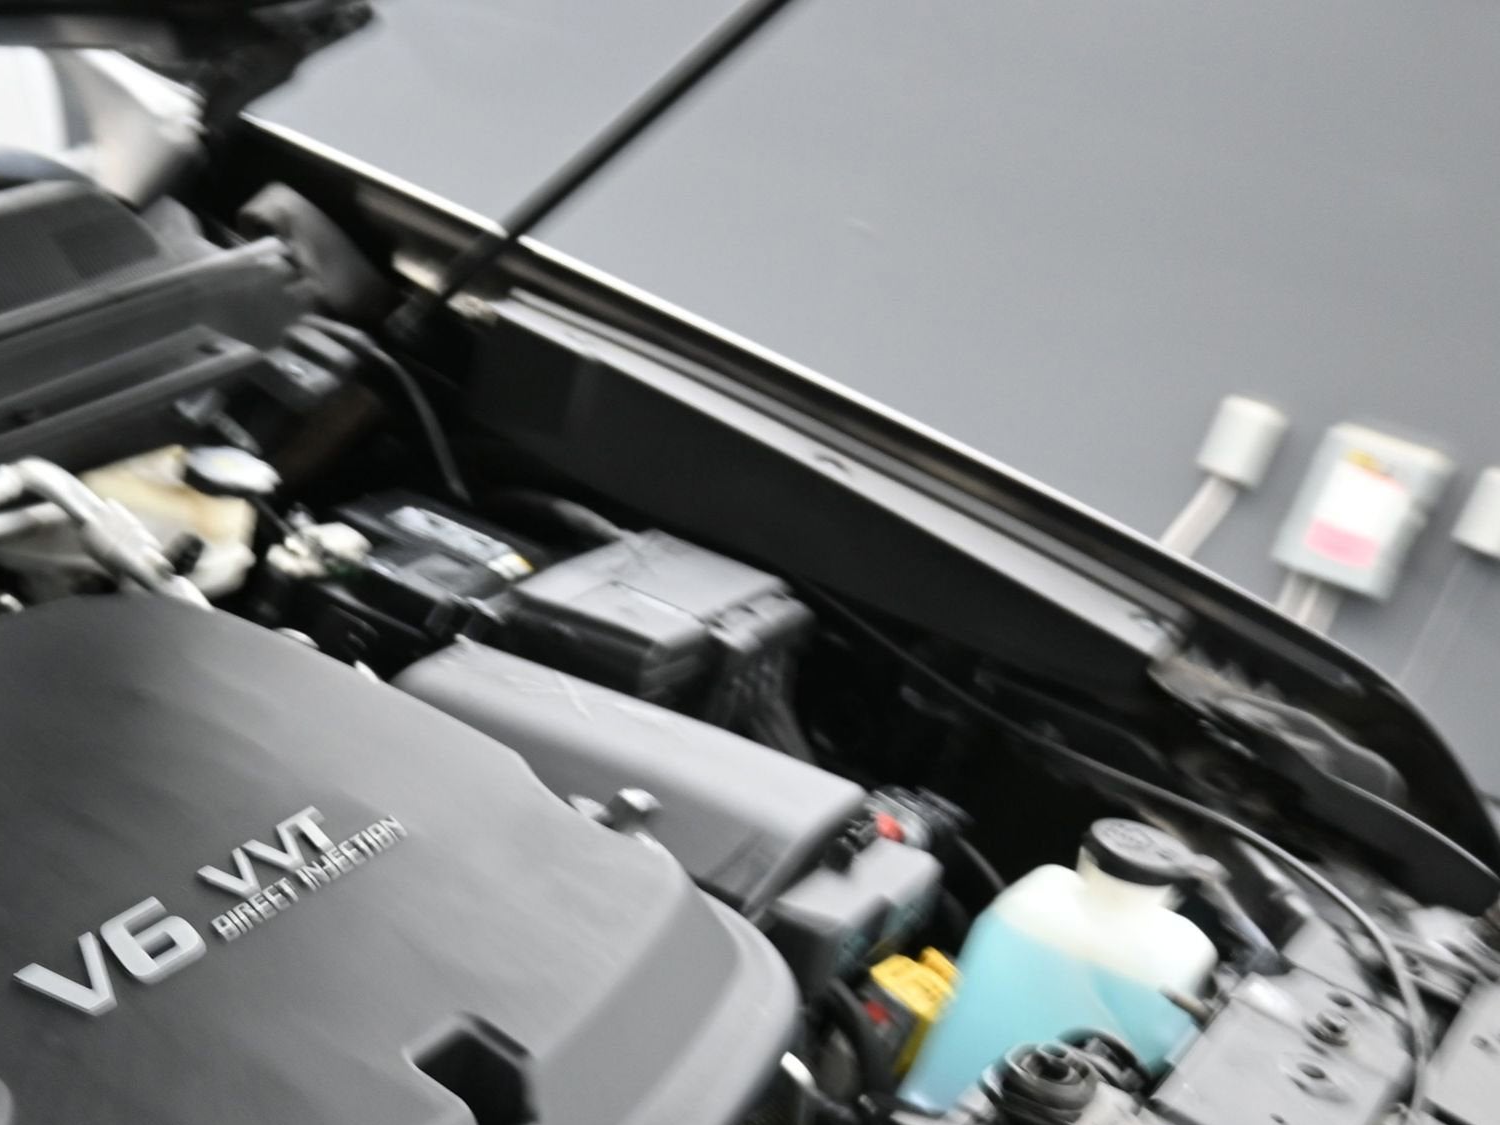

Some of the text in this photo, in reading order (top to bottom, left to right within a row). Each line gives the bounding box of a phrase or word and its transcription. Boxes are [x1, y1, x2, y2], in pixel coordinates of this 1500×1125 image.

[13, 805, 336, 1017] V6 VVT
[211, 815, 408, 942] DIRECT INJECTION
